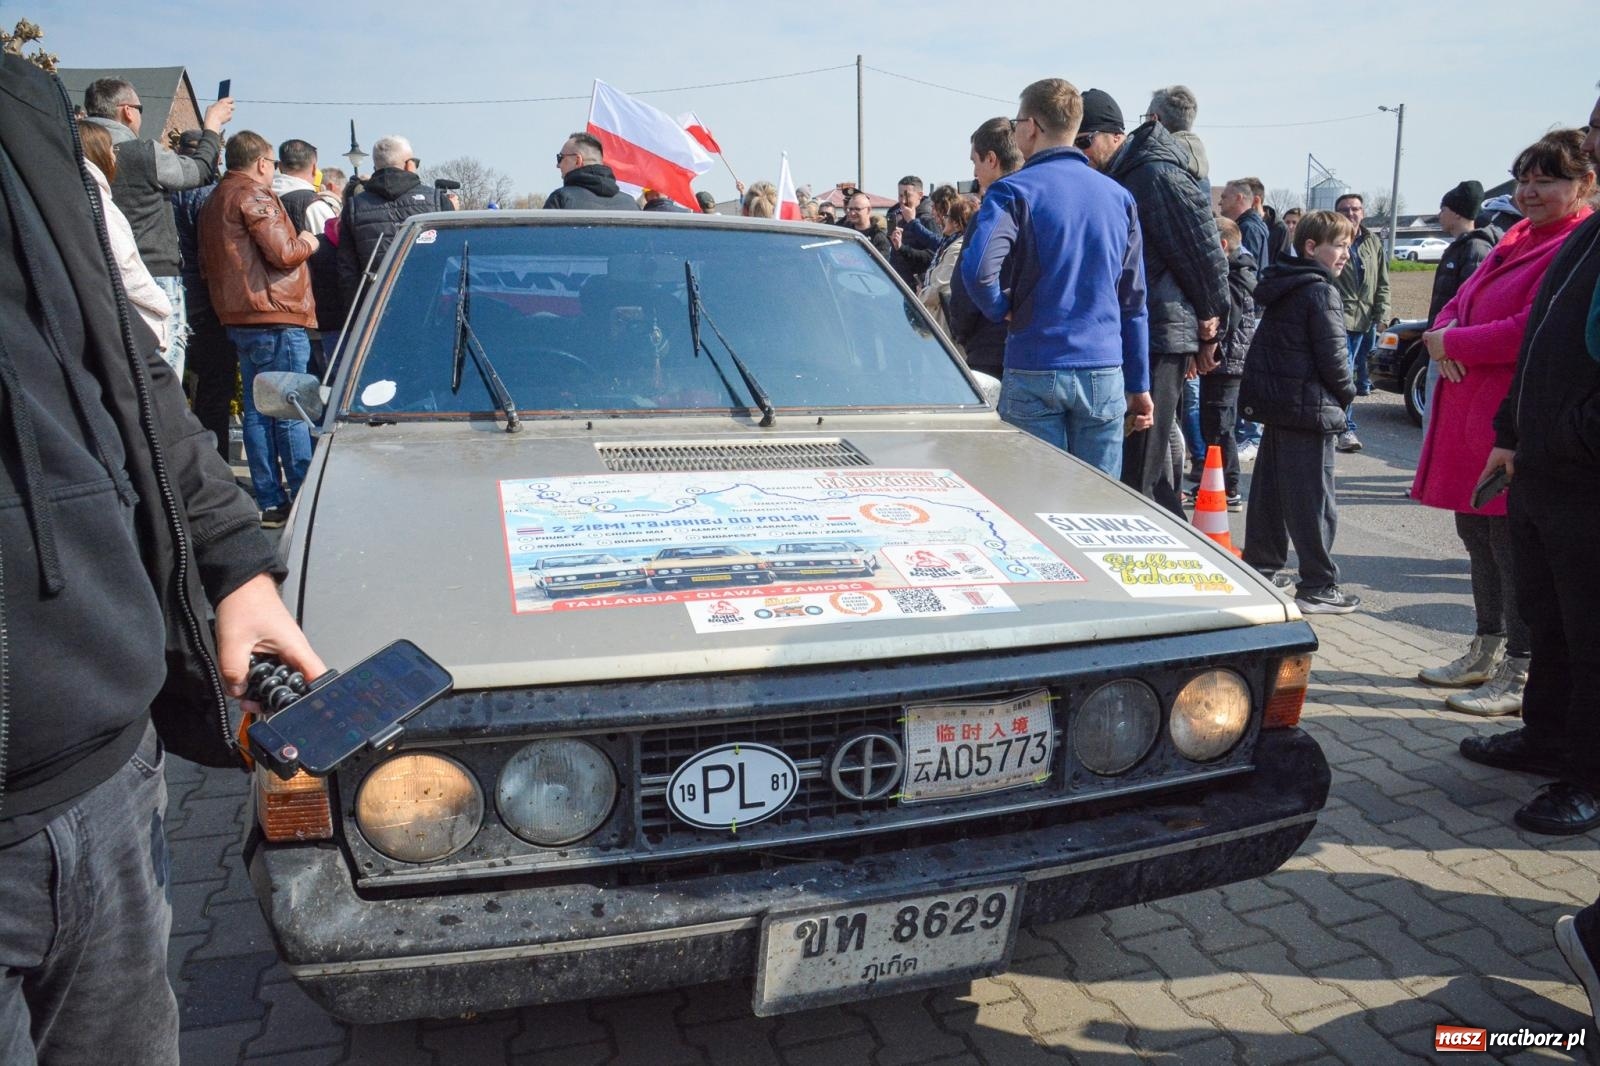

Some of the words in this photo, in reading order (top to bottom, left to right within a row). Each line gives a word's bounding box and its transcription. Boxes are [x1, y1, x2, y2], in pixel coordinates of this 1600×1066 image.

[847, 272, 873, 294] T
[552, 525, 566, 534] Z
[728, 516, 752, 525] DO
[759, 514, 820, 524] POLSKI
[1048, 515, 1160, 533] ŚLIWKA
[1078, 535, 1095, 544] W
[1104, 534, 1177, 545] KOMPOT
[1103, 552, 1203, 573] Yellow
[565, 594, 677, 608] TAJLANDIA
[696, 588, 764, 599] OŁAWA
[782, 582, 863, 593] ZAMOŚĆ
[936, 716, 1030, 743] 临时入境
[914, 731, 1048, 783] 云A05773
[679, 783, 697, 803] 19
[702, 761, 766, 814] PL
[771, 772, 789, 792] 81
[892, 892, 1007, 943] 8629
[861, 952, 918, 984] ภูเก็ต
